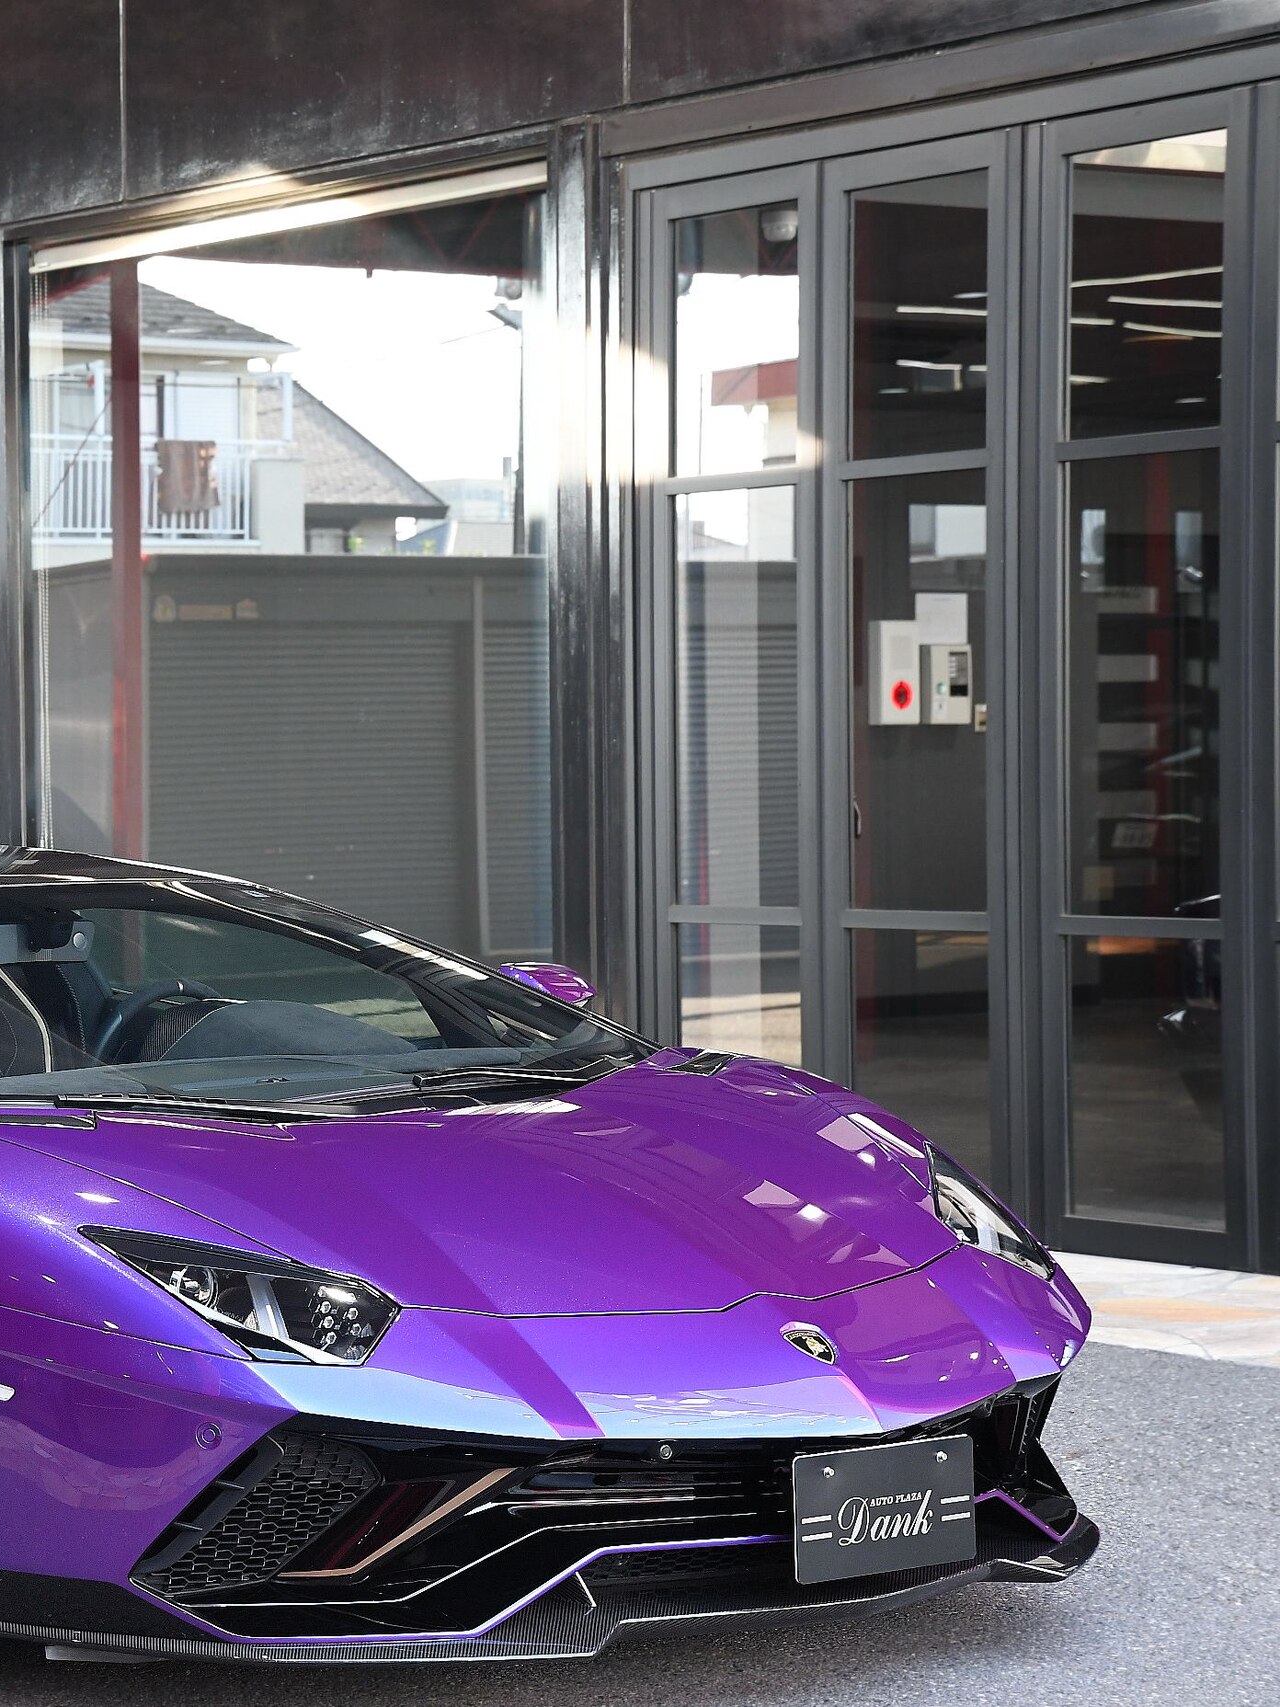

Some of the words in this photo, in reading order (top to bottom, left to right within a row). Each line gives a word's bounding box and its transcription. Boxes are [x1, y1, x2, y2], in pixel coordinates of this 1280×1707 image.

[869, 1497, 894, 1507] AUTO
[895, 1491, 923, 1504] PLAZA
[837, 1489, 934, 1546] Dank
